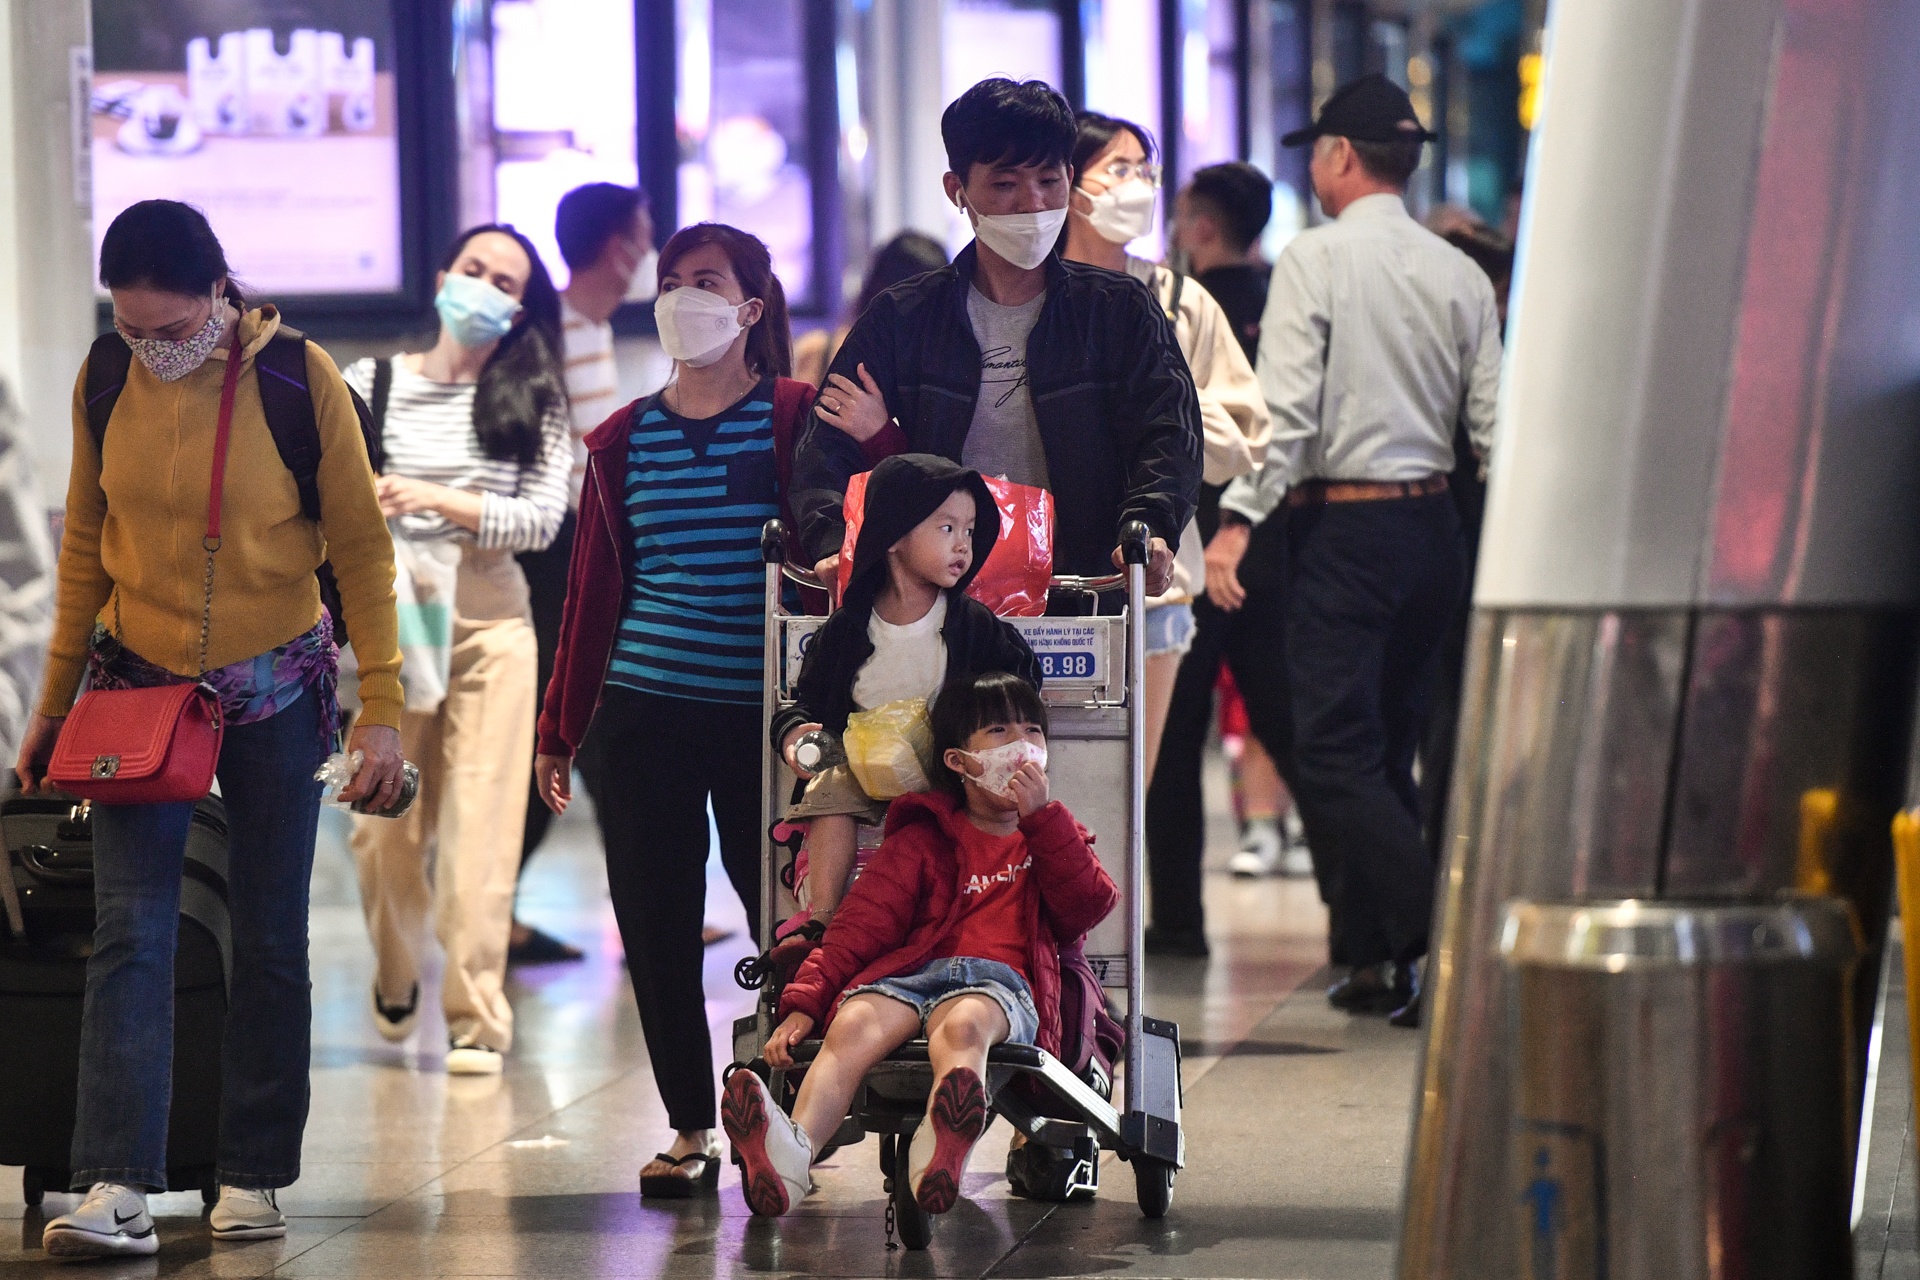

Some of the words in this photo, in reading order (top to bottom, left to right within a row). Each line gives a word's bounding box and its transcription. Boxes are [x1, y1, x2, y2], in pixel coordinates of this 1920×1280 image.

[1023, 628, 1031, 636] XE
[1046, 627, 1062, 636] HÀNH
[1063, 627, 1071, 636] LÝ
[1072, 628, 1082, 637] TẠI
[1083, 627, 1095, 635] CÁC
[1054, 637, 1071, 646] KHÔNG
[1072, 636, 1086, 646] QUỐC
[1087, 636, 1094, 645] TẾ
[1037, 656, 1087, 675] 8.98
